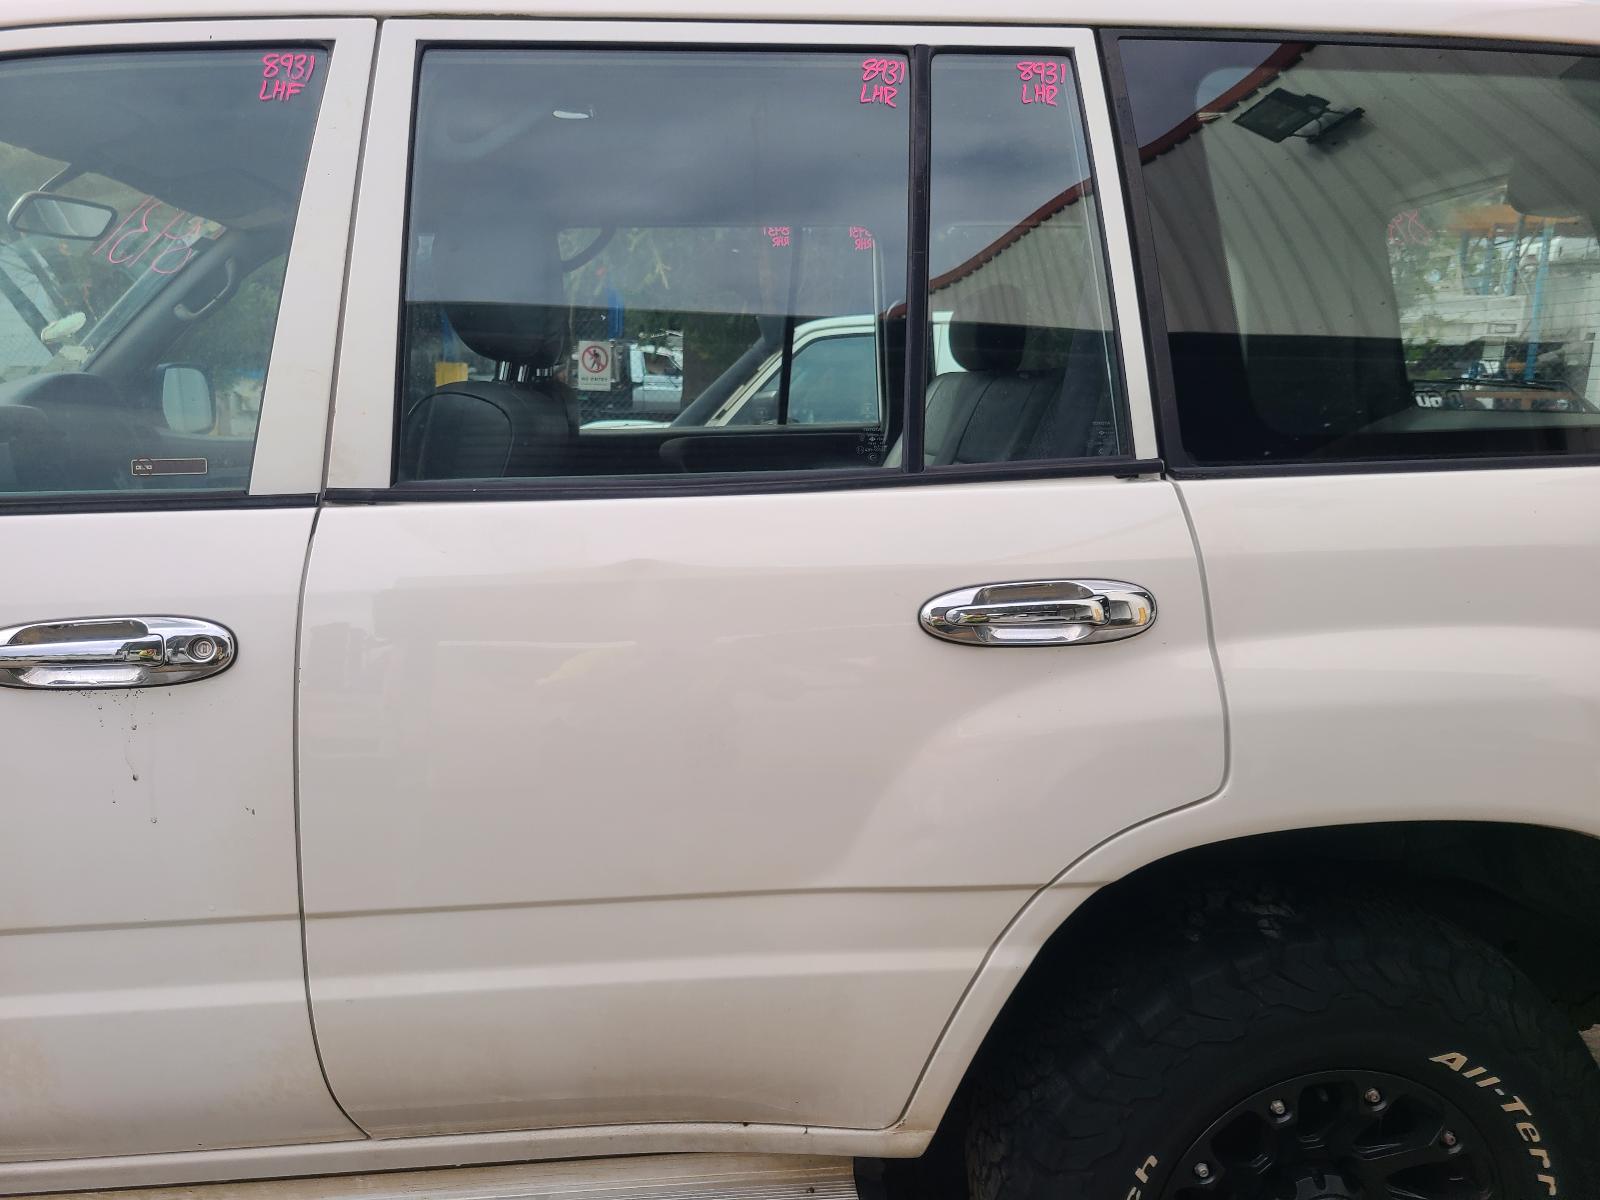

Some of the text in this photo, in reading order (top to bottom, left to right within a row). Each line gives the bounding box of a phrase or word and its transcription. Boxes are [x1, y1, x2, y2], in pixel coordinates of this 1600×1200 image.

[261, 52, 316, 81] 8931
[861, 58, 906, 85] 8931
[1016, 61, 1067, 84] 8931
[258, 79, 306, 102] LHF
[859, 84, 897, 107] LHR
[1021, 83, 1058, 106] LHR
